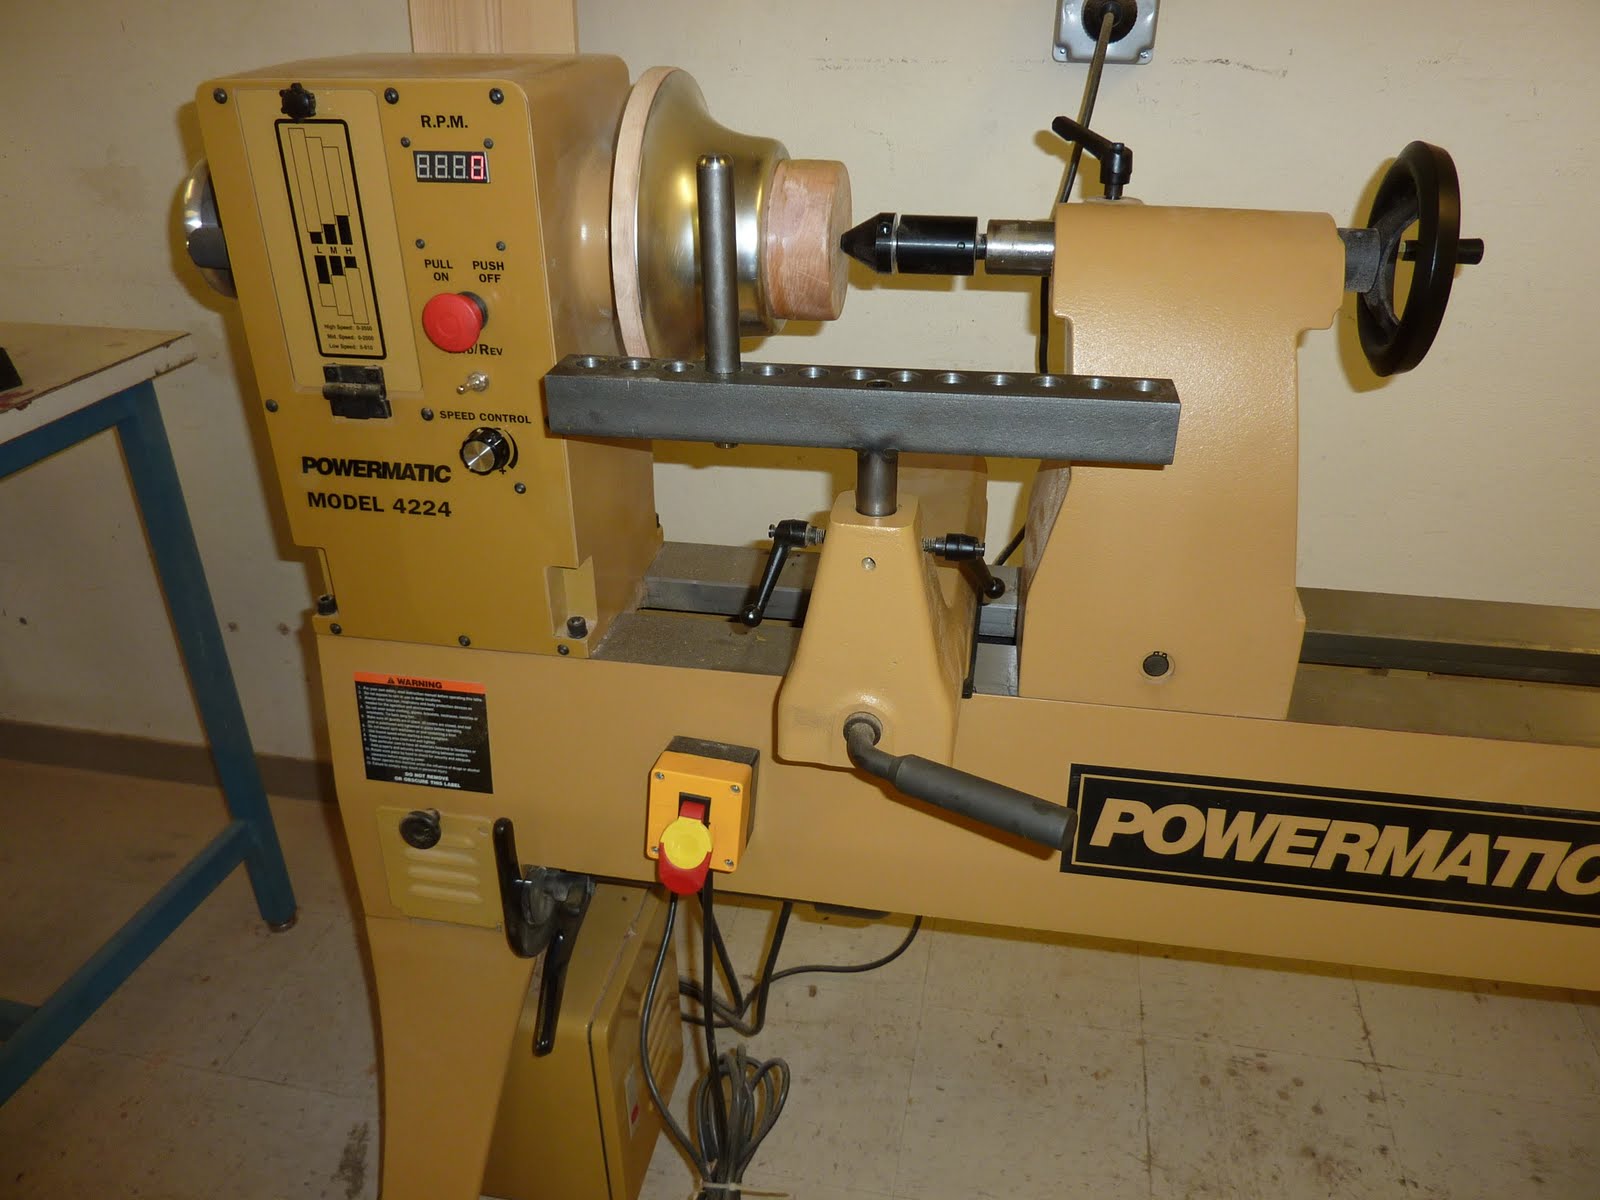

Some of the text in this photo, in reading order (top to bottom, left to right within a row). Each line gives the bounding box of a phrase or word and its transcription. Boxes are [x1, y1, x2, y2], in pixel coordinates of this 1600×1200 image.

[420, 114, 469, 129] R.P.M.
[316, 246, 323, 254] L
[330, 246, 338, 254] M
[345, 246, 353, 255] H
[424, 259, 454, 270] PULL
[472, 260, 505, 271] PUSH
[433, 272, 449, 281] ON
[479, 273, 502, 283] OFF
[439, 410, 532, 424] SPEED CONTROL
[301, 456, 452, 484] POWERMATIC
[307, 491, 452, 517] MODEL 4224
[396, 677, 443, 689] WARNING
[1089, 797, 1600, 896] POWERMATIC
